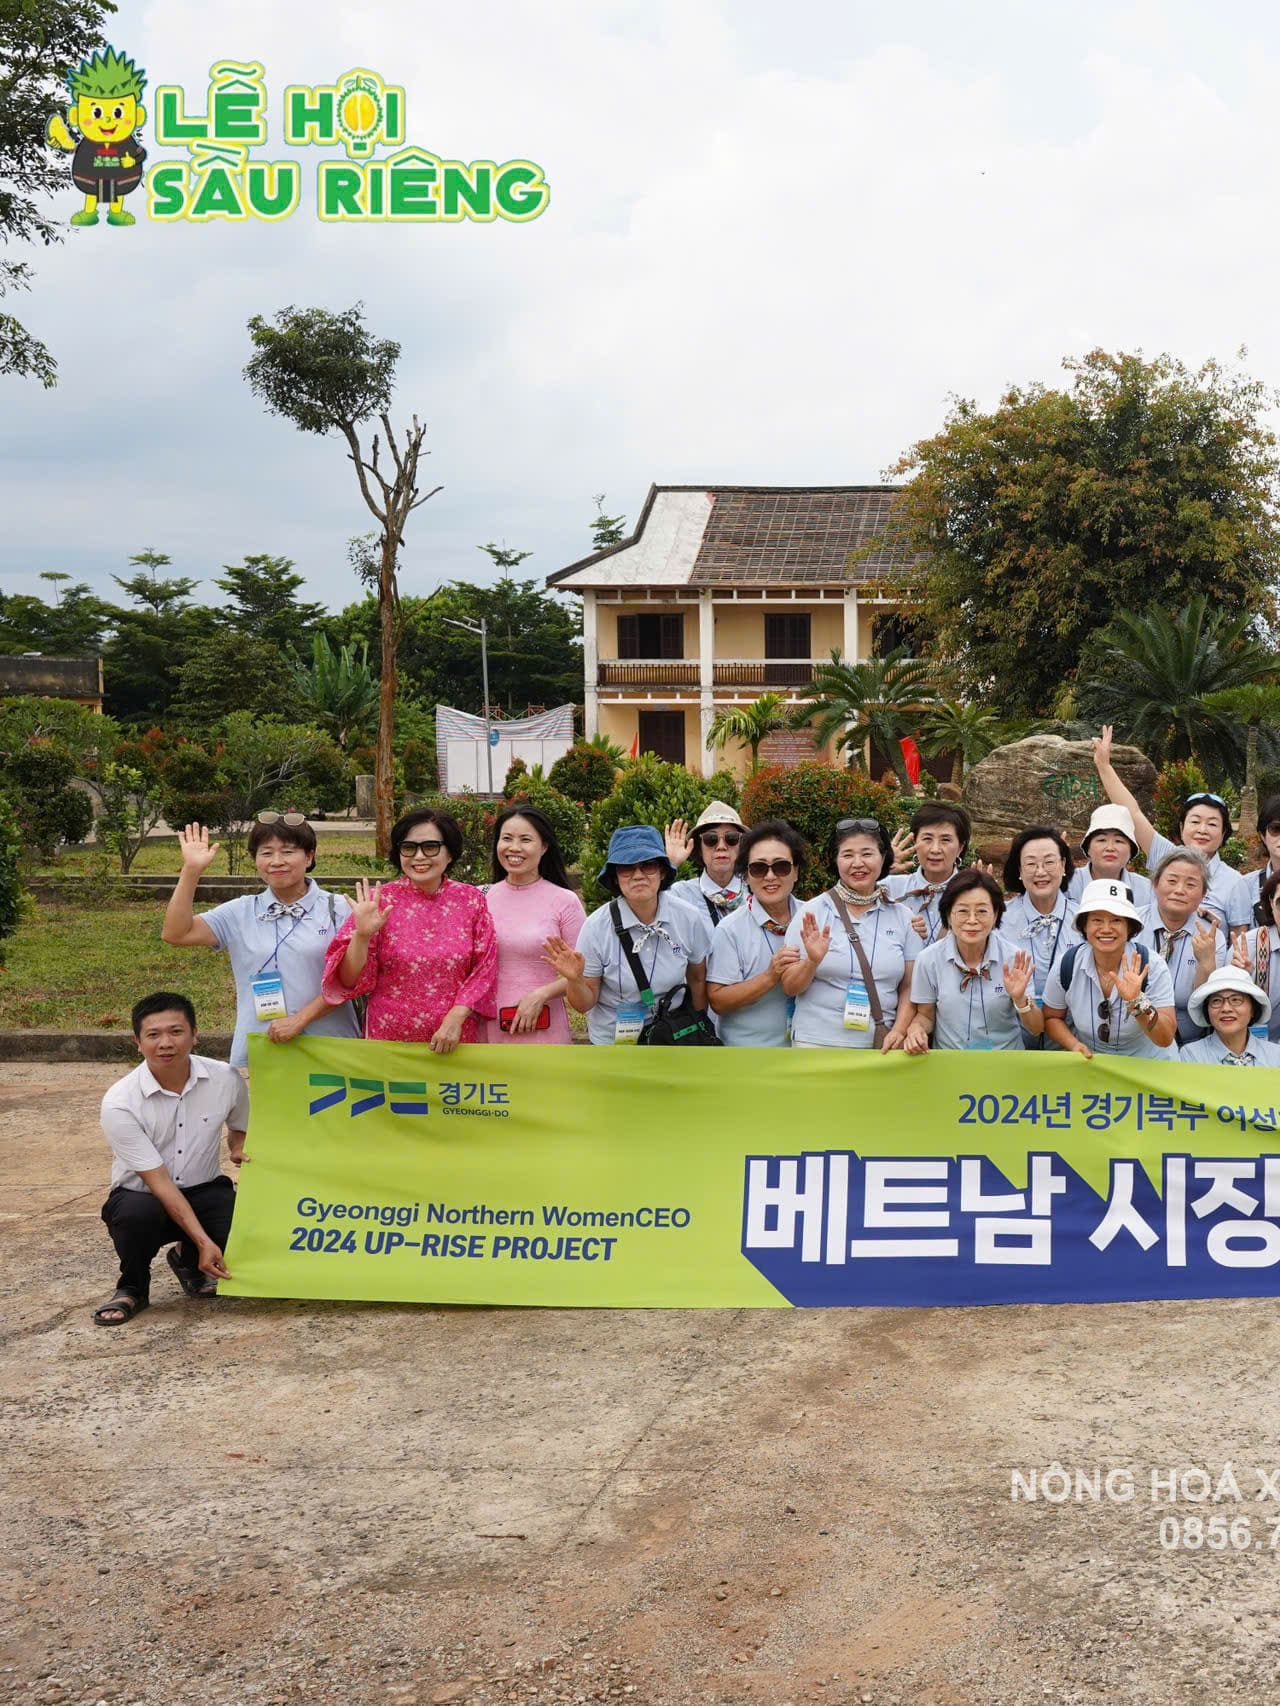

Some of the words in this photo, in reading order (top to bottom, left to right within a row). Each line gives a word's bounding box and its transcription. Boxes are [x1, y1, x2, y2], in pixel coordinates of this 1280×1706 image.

[1110, 886, 1118, 896] B
[438, 1082, 510, 1105] 경기도
[958, 1093, 1071, 1129] 2024년
[1081, 1092, 1209, 1131] 경기북부
[296, 1197, 419, 1227] Gyeonggi
[427, 1202, 535, 1226] Northern
[543, 1205, 691, 1229] WomenCEO
[746, 1153, 1067, 1266] 베트남
[289, 1227, 358, 1255] 2024
[492, 1235, 618, 1261] PROJECT
